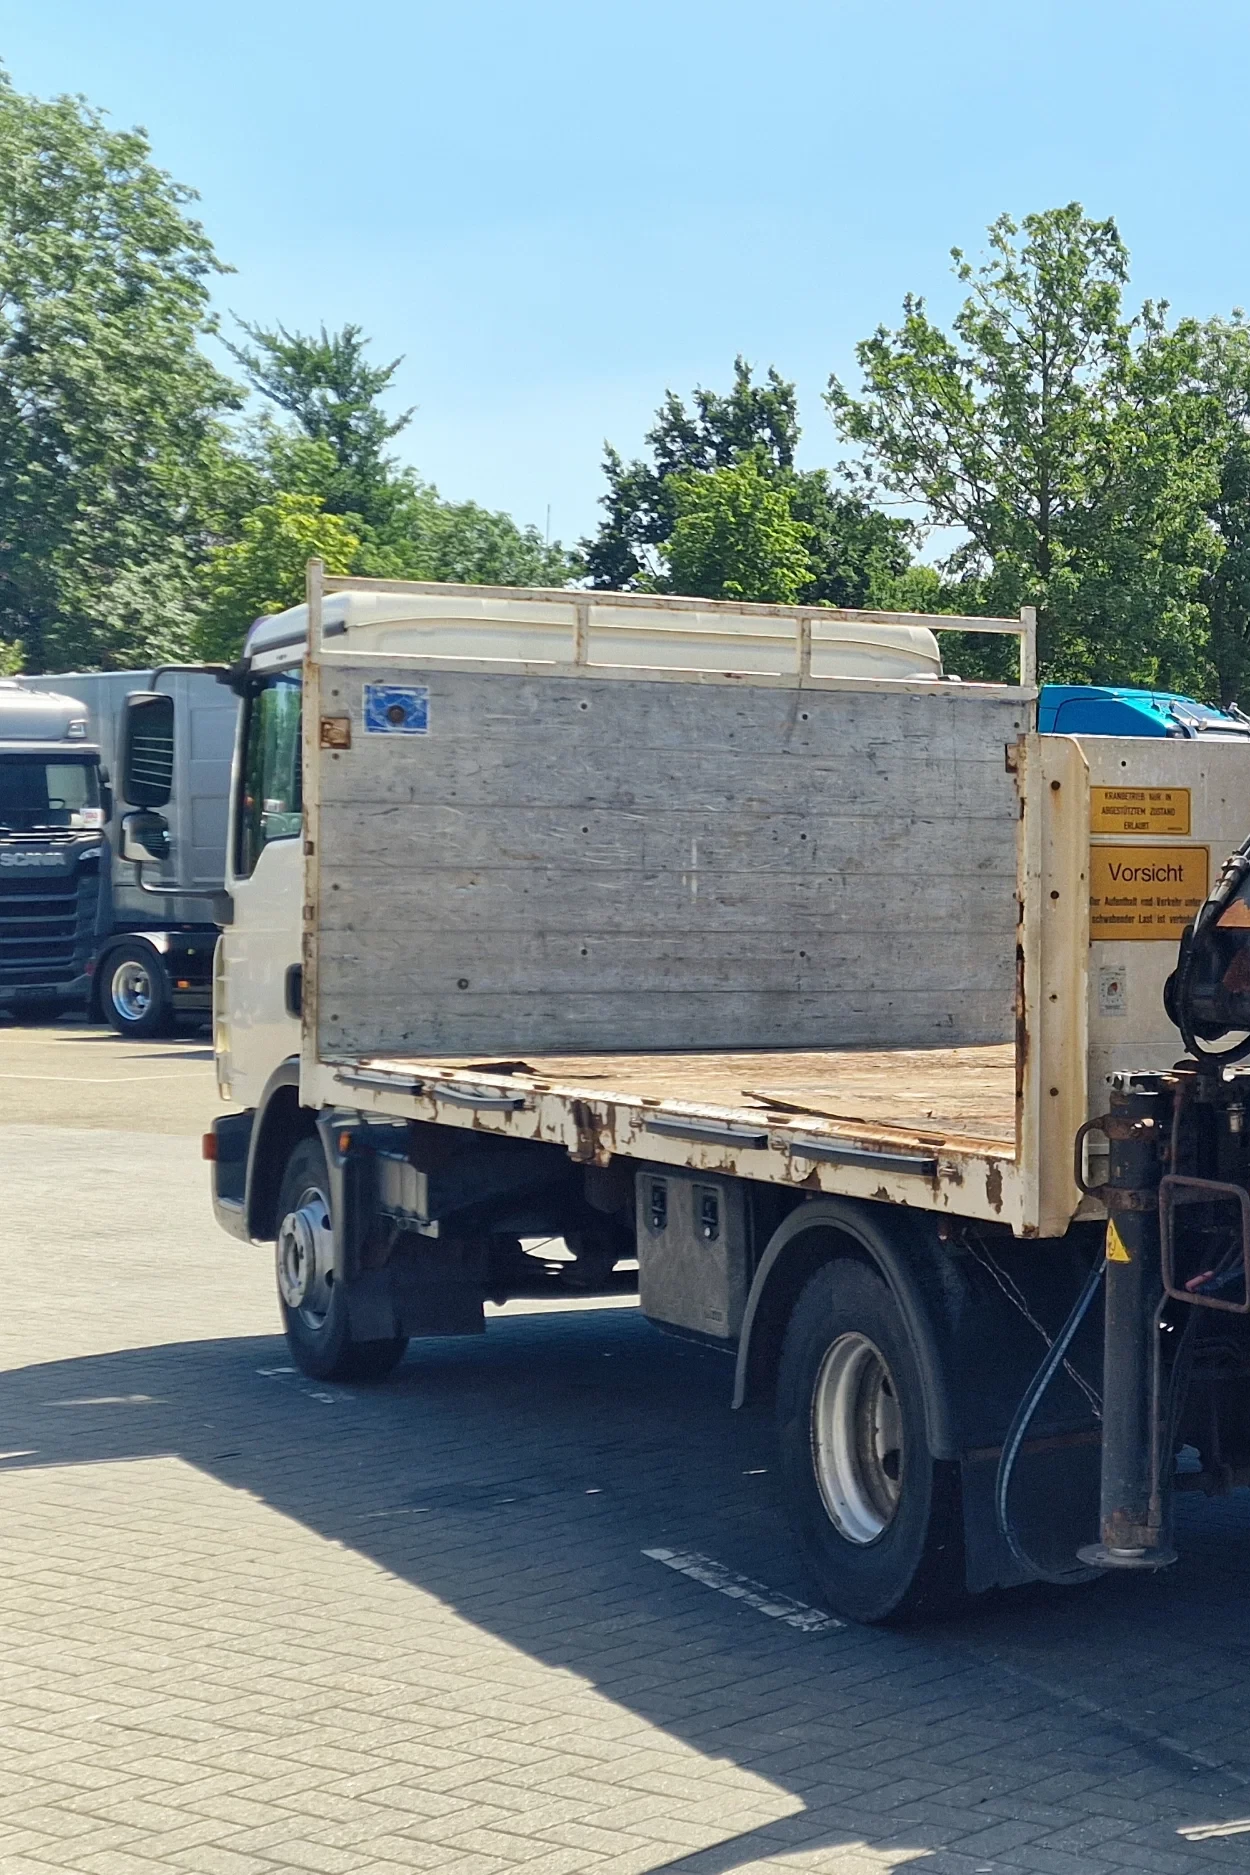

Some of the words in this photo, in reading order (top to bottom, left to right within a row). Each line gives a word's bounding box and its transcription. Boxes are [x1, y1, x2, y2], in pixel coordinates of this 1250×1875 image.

[1149, 793, 1161, 801] NUR
[1165, 793, 1172, 801] IN
[1150, 807, 1175, 816] ZUSTAND
[1123, 821, 1150, 830] ERLAUBT
[1108, 862, 1184, 882] Vorsicht
[1138, 914, 1153, 924] Last
[1157, 914, 1166, 924] ist
